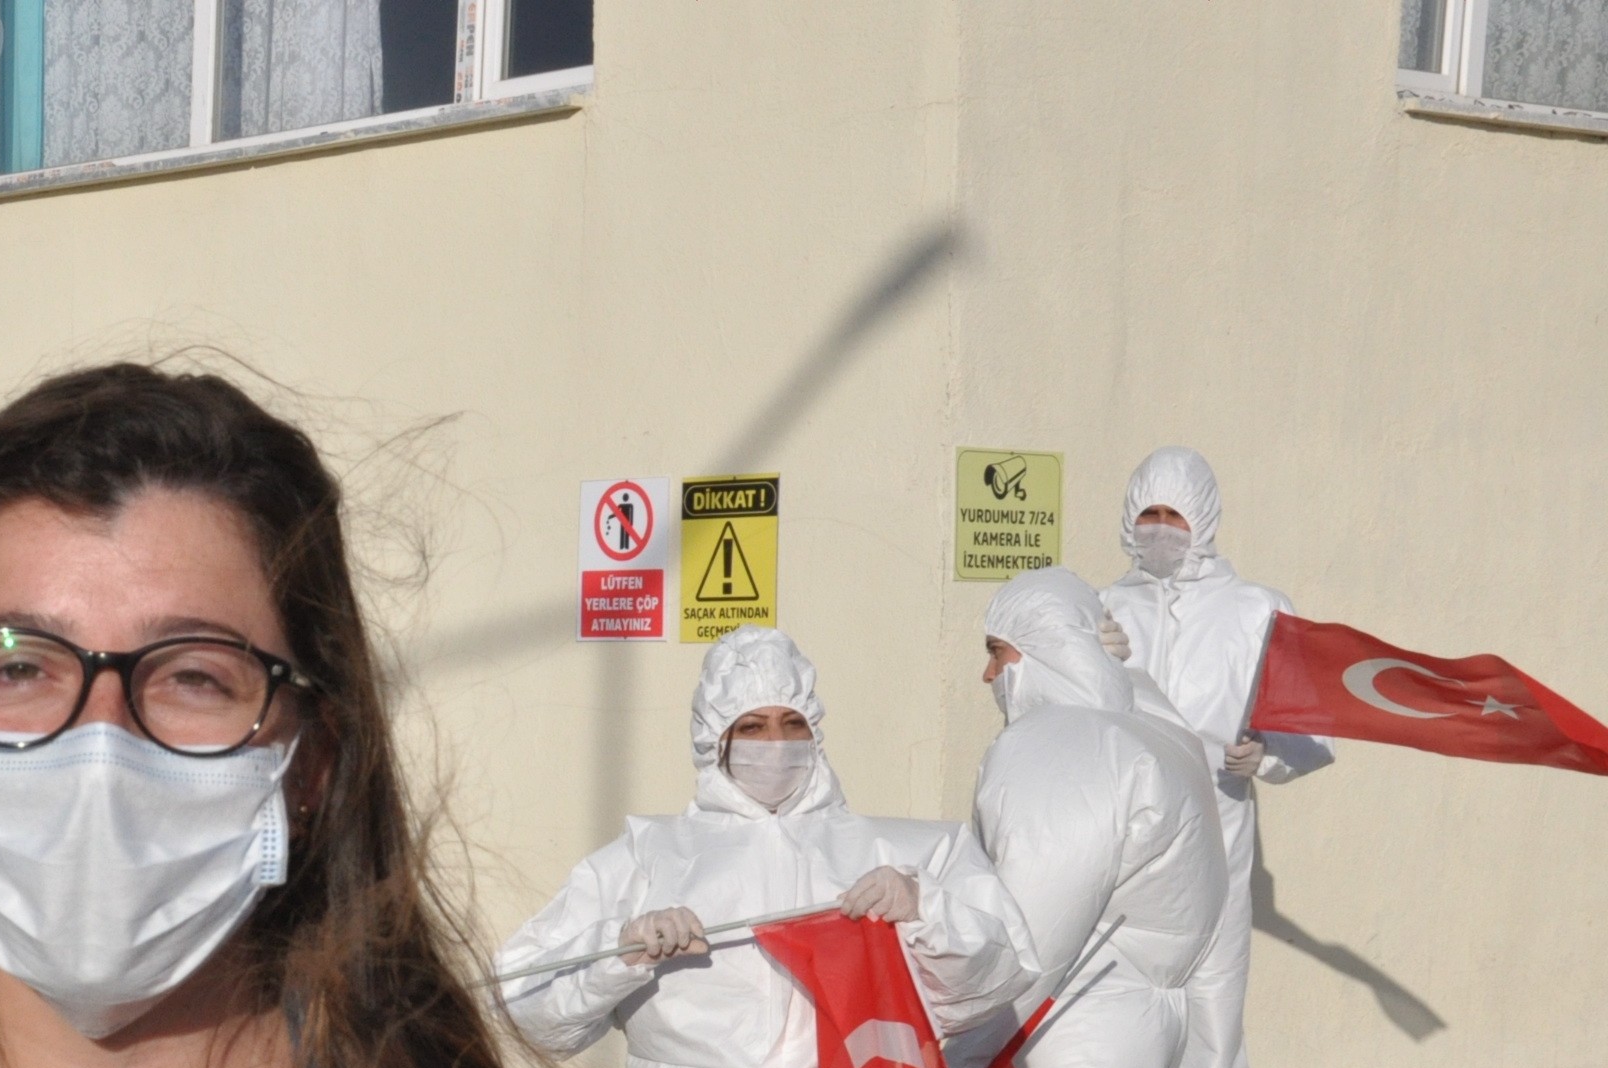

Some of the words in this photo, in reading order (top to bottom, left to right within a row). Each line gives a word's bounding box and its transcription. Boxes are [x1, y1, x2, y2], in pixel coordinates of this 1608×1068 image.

[693, 487, 756, 510] DİKKAT
[760, 488, 766, 507] !
[960, 508, 1026, 525] YURDUMUZ
[1029, 511, 1055, 526] 7/24
[973, 531, 1022, 547] KAMERA
[1024, 530, 1041, 548] İLE
[963, 550, 1053, 570] İZLENMEKTEDİR
[601, 576, 643, 590] LÜTFEN
[585, 598, 633, 611] YERLERE
[636, 596, 659, 614] ÇÖP
[683, 607, 716, 621] SAÇAK
[719, 607, 769, 619] ALTINDAN
[591, 618, 651, 631] ATMAYINIZ
